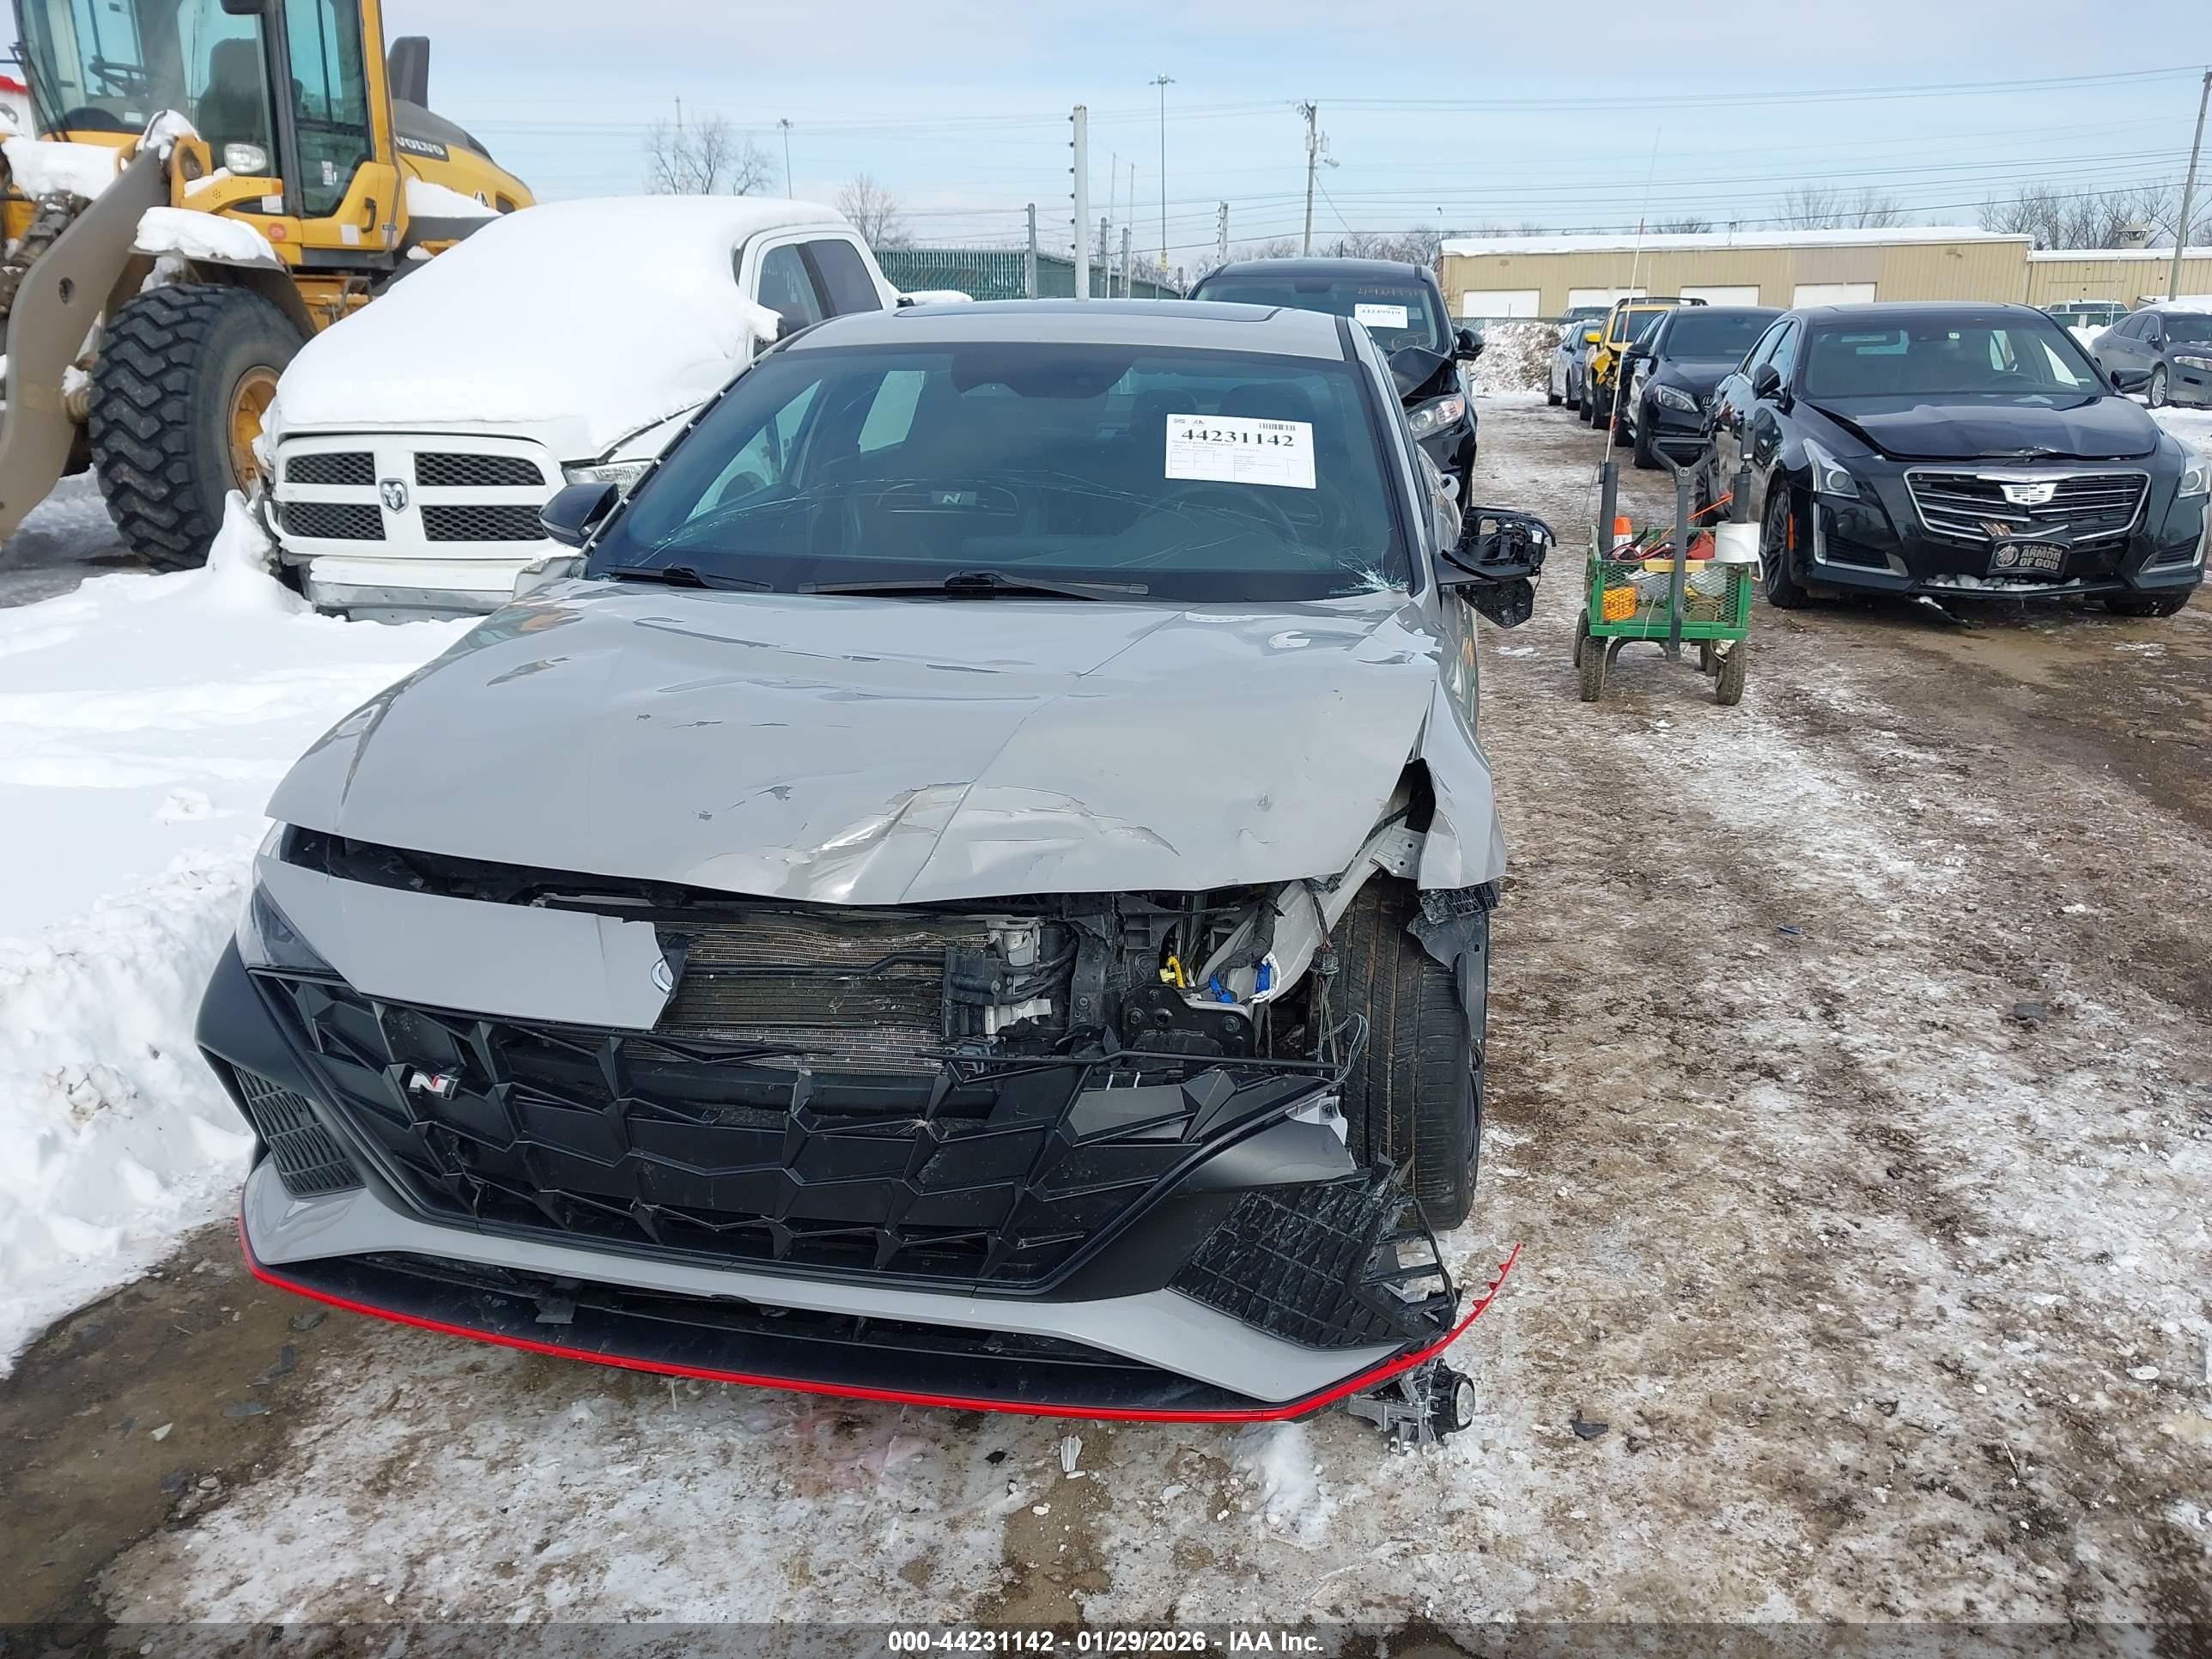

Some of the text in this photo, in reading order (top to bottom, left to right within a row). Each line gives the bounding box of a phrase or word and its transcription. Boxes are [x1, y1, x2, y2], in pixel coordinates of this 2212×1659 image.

[395, 137, 445, 155] VOLVO
[1182, 428, 1295, 447] 44231142
[2021, 548, 2062, 562] ARMOR
[2019, 557, 2059, 571] OF GOD
